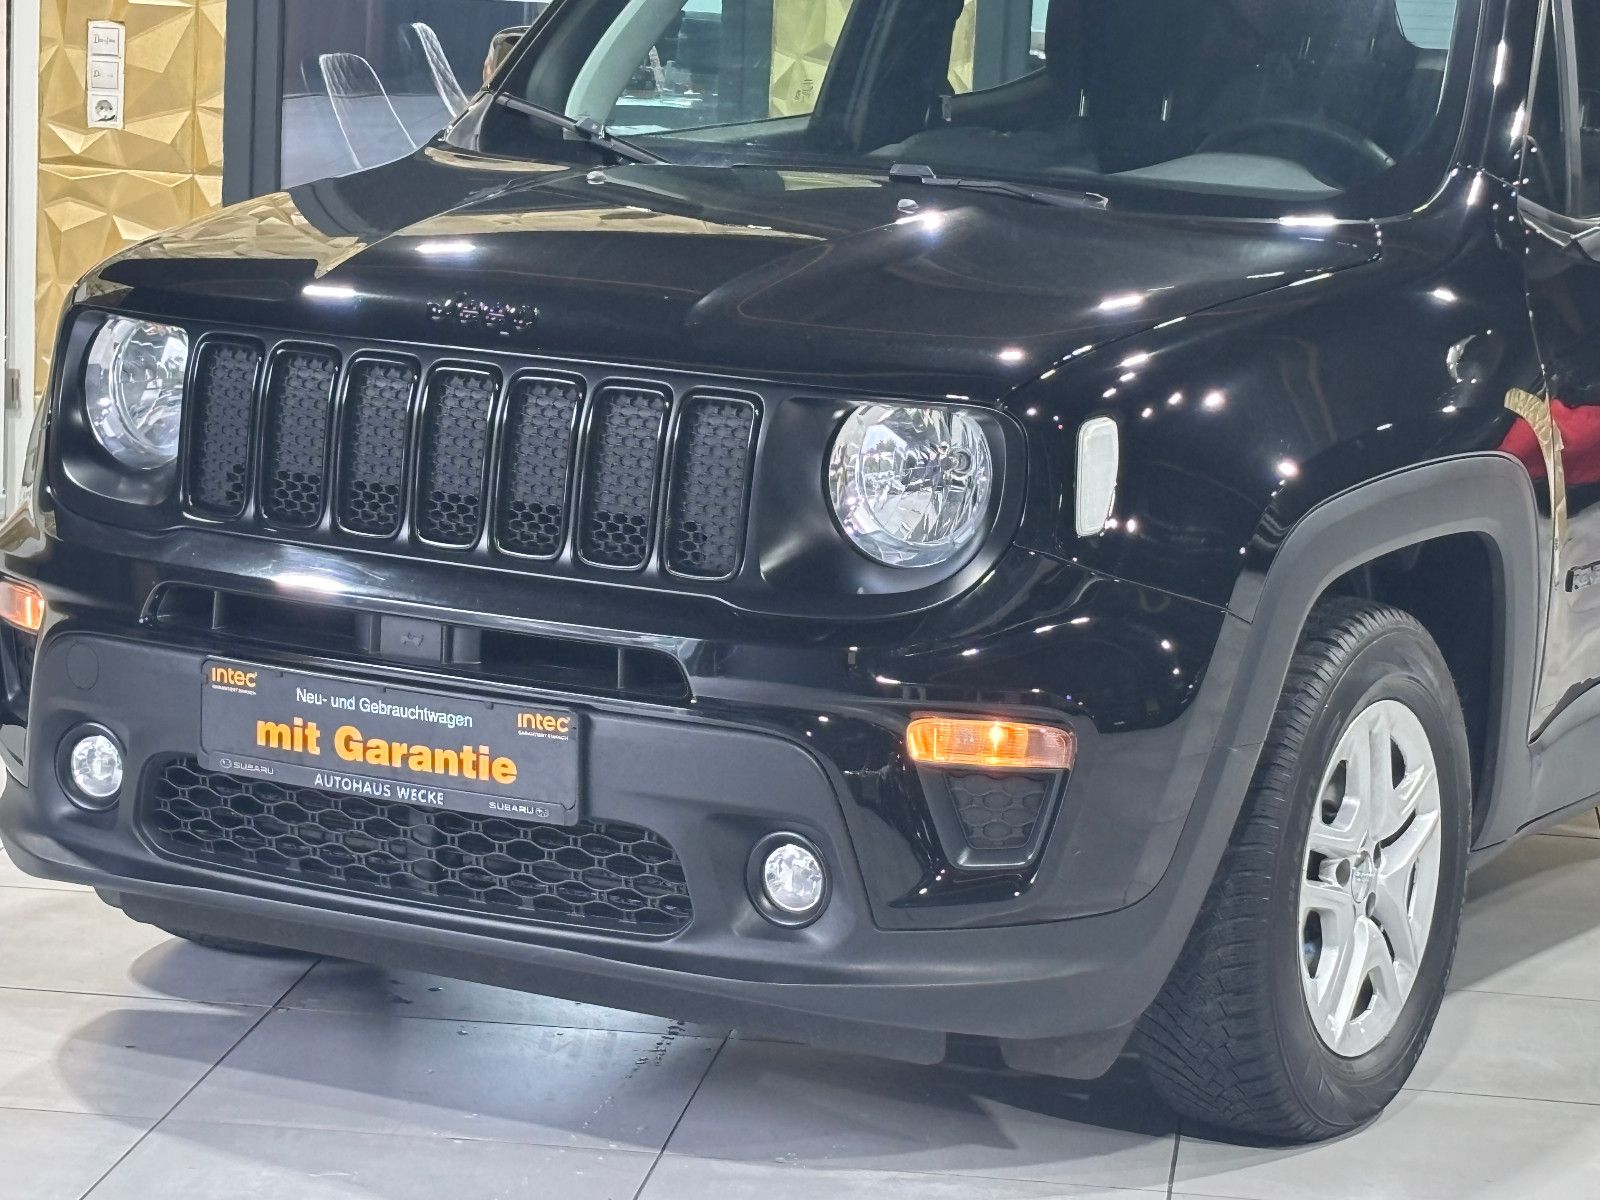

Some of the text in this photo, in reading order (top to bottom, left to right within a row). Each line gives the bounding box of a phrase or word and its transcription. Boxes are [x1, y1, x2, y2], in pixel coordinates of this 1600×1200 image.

[296, 687, 473, 728] Neu- und Gebrauchtwagen
[257, 717, 518, 785] mit Garantie
[233, 761, 274, 775] SUBARU
[314, 773, 445, 805] AUTOHAUS WECKE
[488, 801, 534, 815] SUBARU
